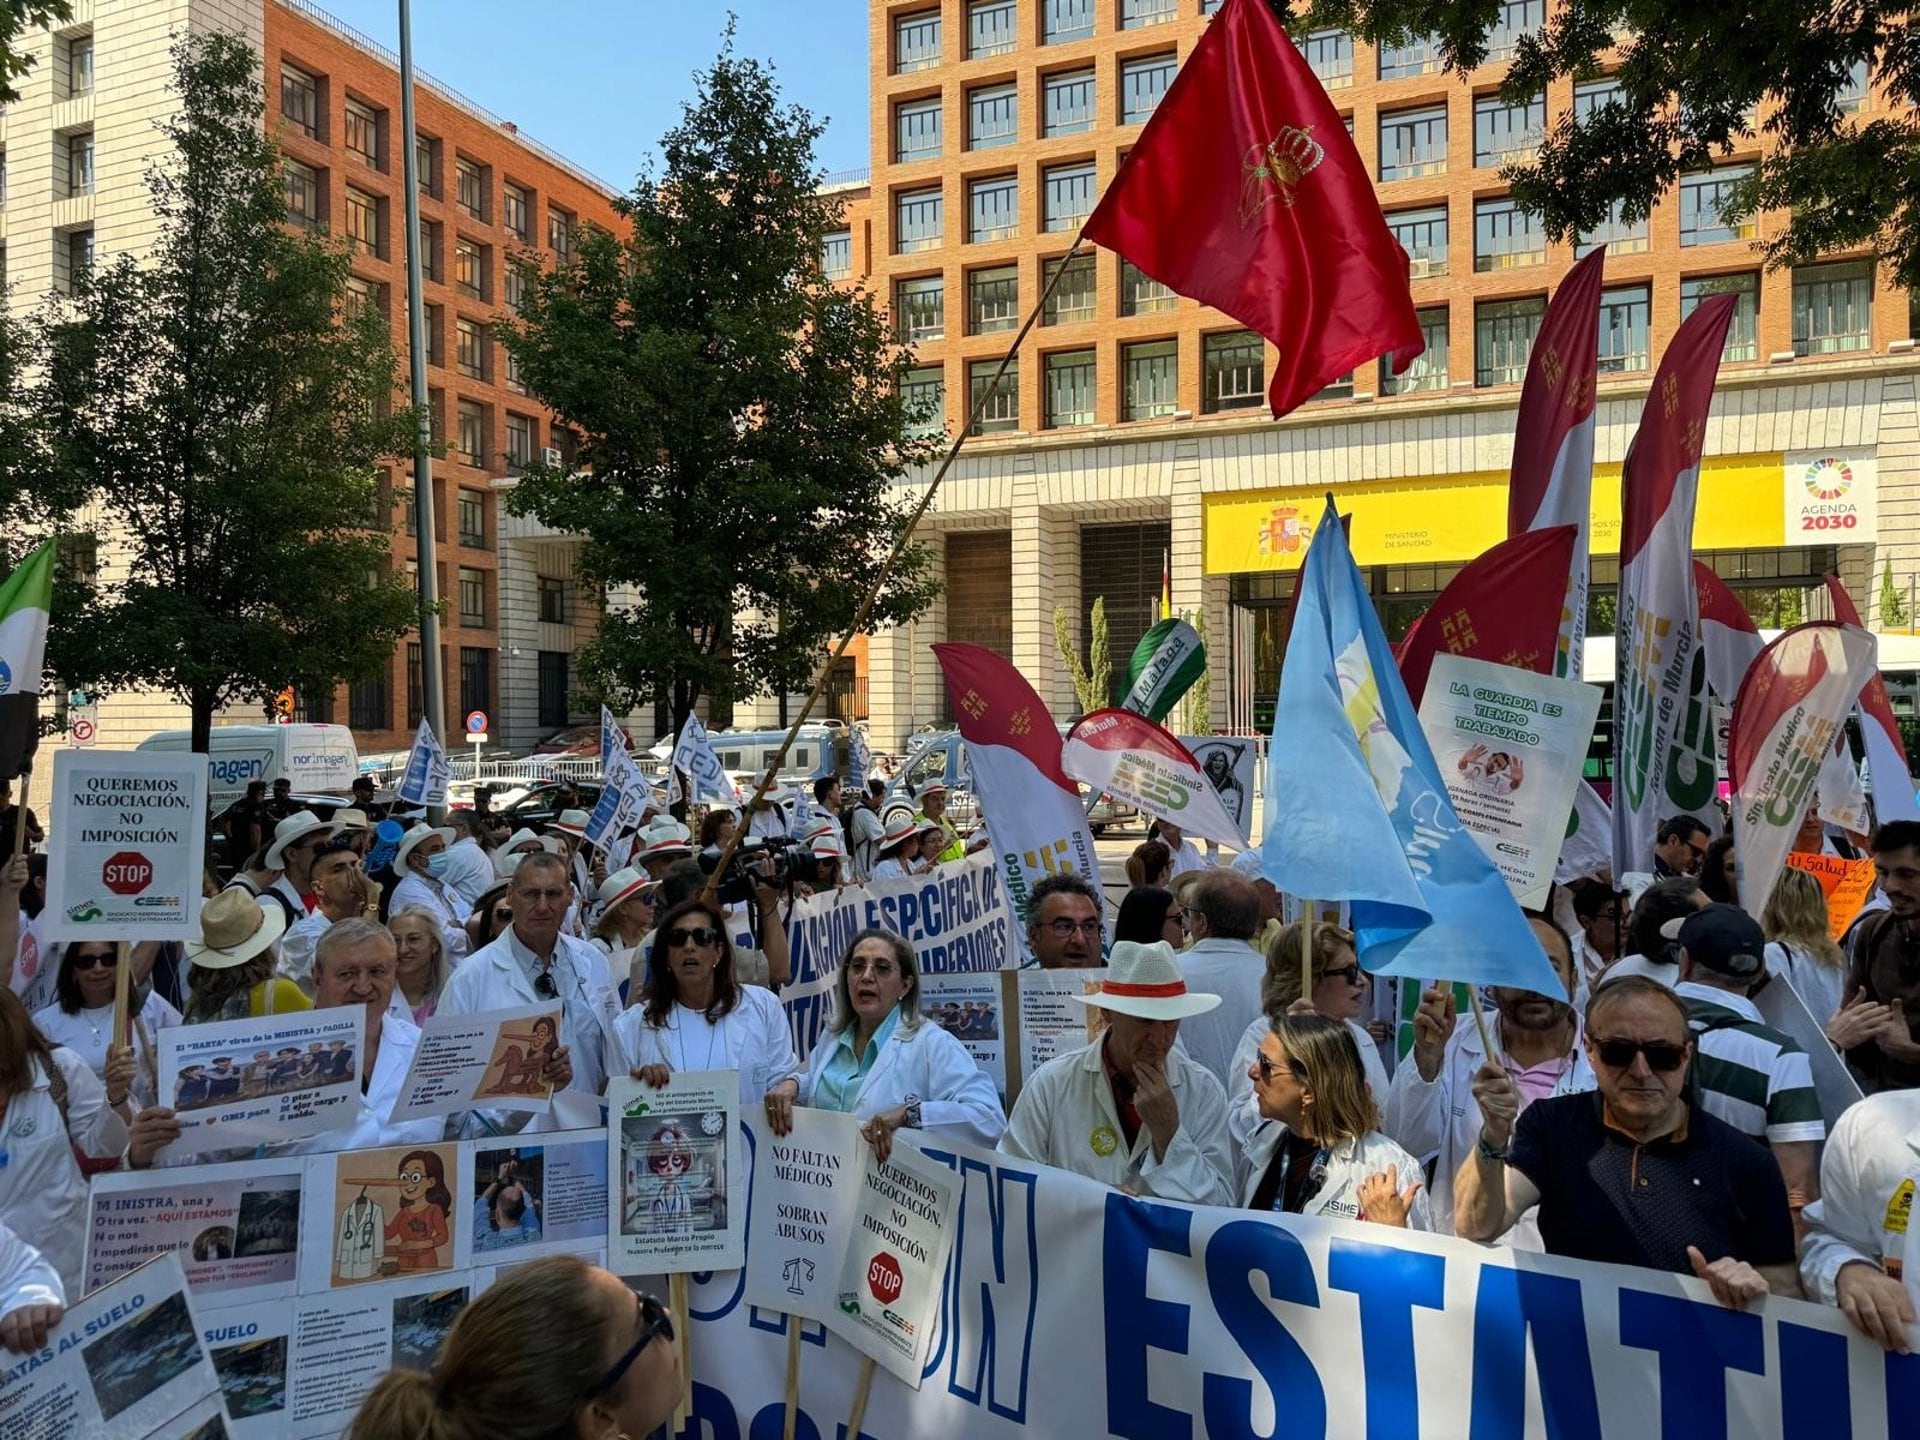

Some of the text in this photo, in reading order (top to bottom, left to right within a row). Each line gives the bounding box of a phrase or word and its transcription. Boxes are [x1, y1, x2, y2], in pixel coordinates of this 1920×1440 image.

[1800, 503, 1857, 515] AGENDA
[1801, 514, 1857, 530] 2030
[1385, 530, 1428, 539] MINISTERIO
[1662, 620, 1692, 694] Murcia
[1450, 682, 1563, 718] LA GUARDIA ES
[1474, 704, 1529, 727] TIEMPO
[1659, 695, 1674, 724] de
[1455, 716, 1540, 746] TRABAJADO
[87, 777, 178, 792] QUEREMOS
[73, 793, 190, 809] NEGOCIACIÓN,
[1459, 795, 1479, 806] horas
[1478, 792, 1516, 807] ORDINARIA
[119, 812, 143, 825] NO
[1472, 820, 1500, 834] ESPECIAL
[81, 828, 178, 843] IMPOSICIÓN
[1072, 830, 1092, 880] Murcia
[106, 865, 150, 883] STOP
[1804, 855, 1847, 877] Salud
[66, 899, 96, 916] simex
[865, 869, 982, 941] ESPCÍFICA
[983, 862, 1001, 913] DE
[229, 1036, 251, 1046] virus
[252, 1035, 263, 1043] de
[264, 1033, 272, 1041] la
[274, 1027, 315, 1039] MINISTRA
[316, 1027, 322, 1035] y
[322, 1022, 355, 1033] PADILLA
[991, 1053, 996, 1061] y
[292, 1092, 312, 1103] ptar
[292, 1102, 311, 1113] ejor
[314, 1096, 339, 1107] cargo
[340, 1094, 348, 1103] y
[247, 1107, 270, 1119] para
[771, 1145, 841, 1170] NO FALTAN
[774, 1163, 833, 1188] MÉDICOS
[877, 1161, 938, 1204] QUEREMOS
[181, 1197, 204, 1206] una
[205, 1196, 214, 1207] y
[865, 1172, 941, 1230] NEGOCIACIÓN,
[108, 1217, 124, 1226] tra
[776, 1202, 828, 1226] SOBRAN
[890, 1208, 907, 1228] NO
[118, 1231, 138, 1240] nos
[635, 1233, 715, 1244] Estatuto Marco Propio
[775, 1223, 825, 1245] ABUSOS
[863, 1214, 928, 1264] IMPOSICIÓN
[156, 1243, 177, 1253] que
[179, 1240, 189, 1250] lo
[700, 1243, 724, 1251] merece
[869, 1261, 901, 1294] STOP
[58, 1330, 83, 1355] AL
[85, 1294, 145, 1336] SUELO
[204, 1323, 258, 1343] SUELO
